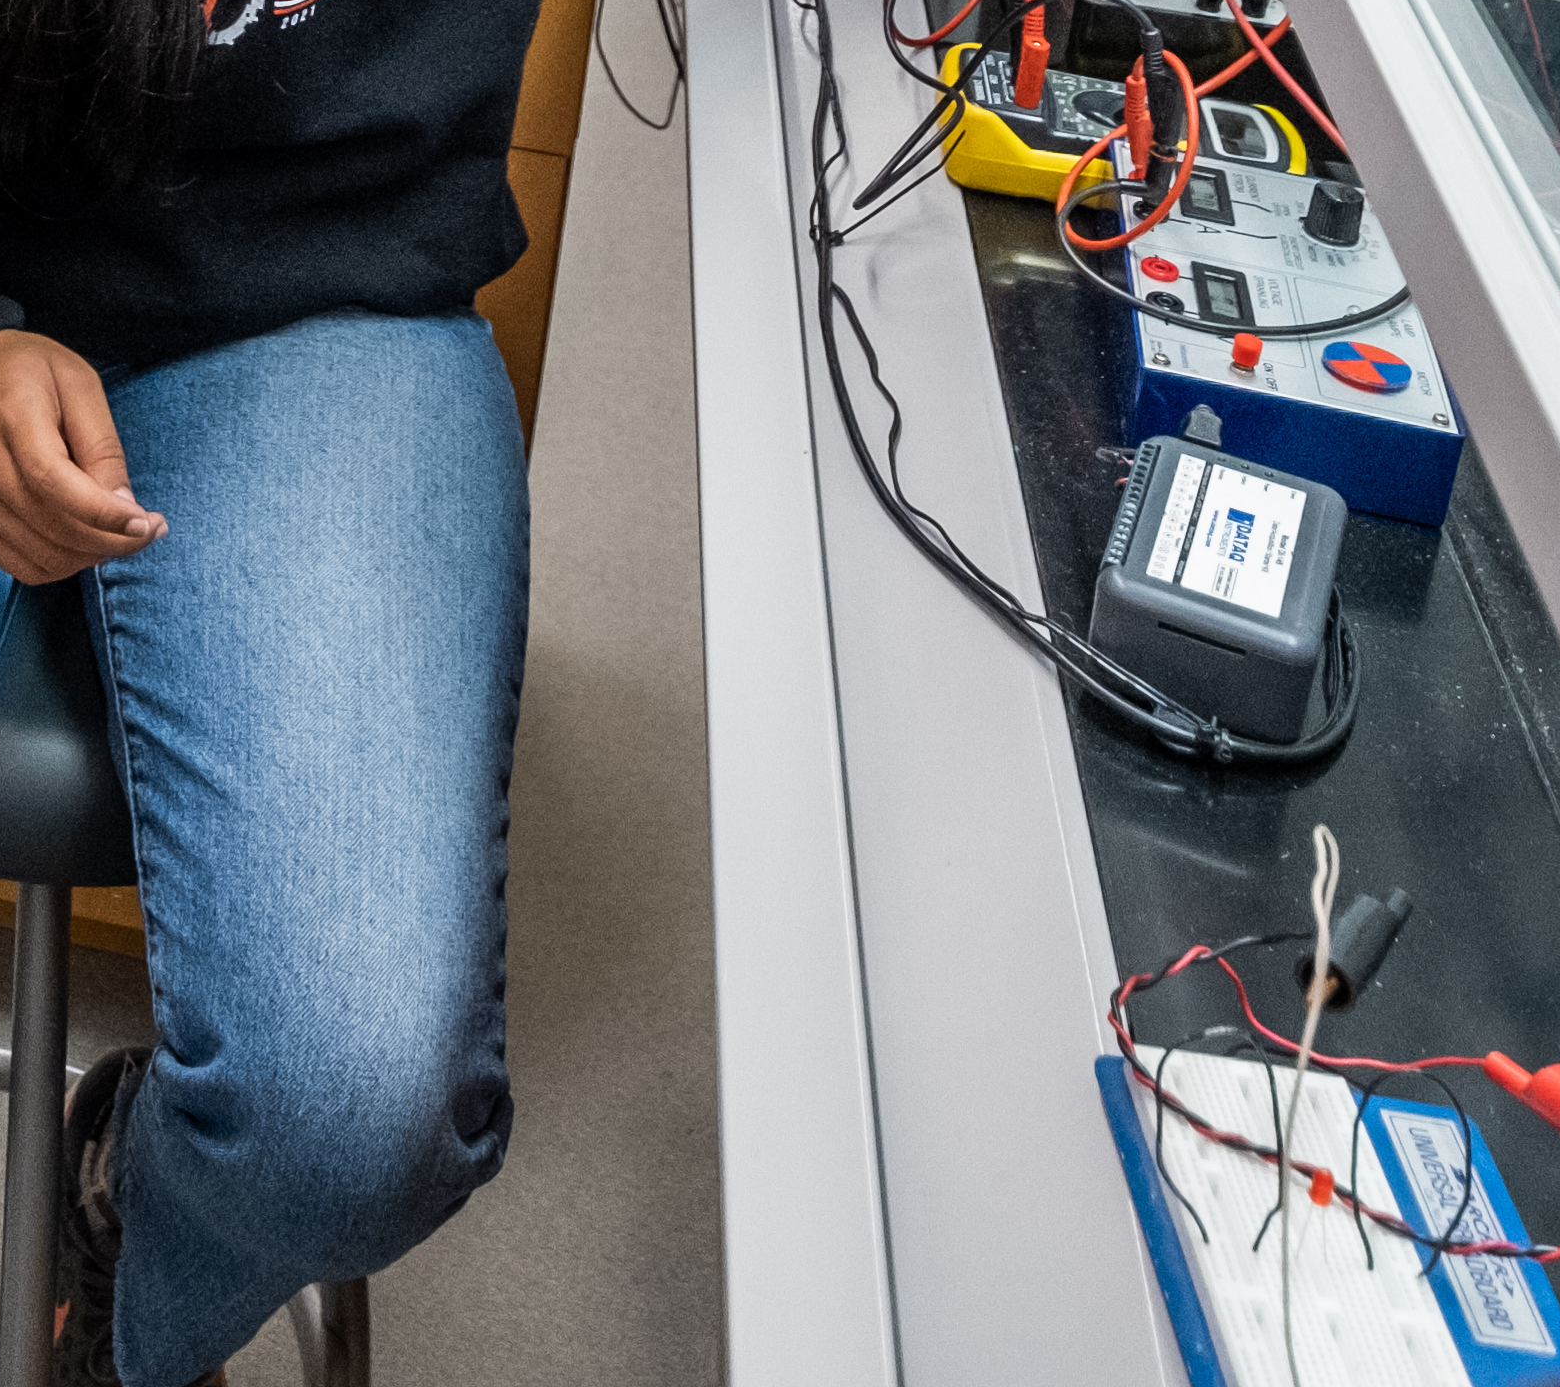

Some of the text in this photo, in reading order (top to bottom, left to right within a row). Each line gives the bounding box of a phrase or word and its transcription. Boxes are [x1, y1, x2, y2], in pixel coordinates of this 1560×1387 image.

[279, 3, 317, 30] 2021
[1196, 222, 1222, 234] A
[1268, 277, 1283, 307] VOLTAGE
[1265, 377, 1279, 392] OFF
[1229, 522, 1253, 563] DATAQ
[1408, 1126, 1458, 1209] UNIVERSAL
